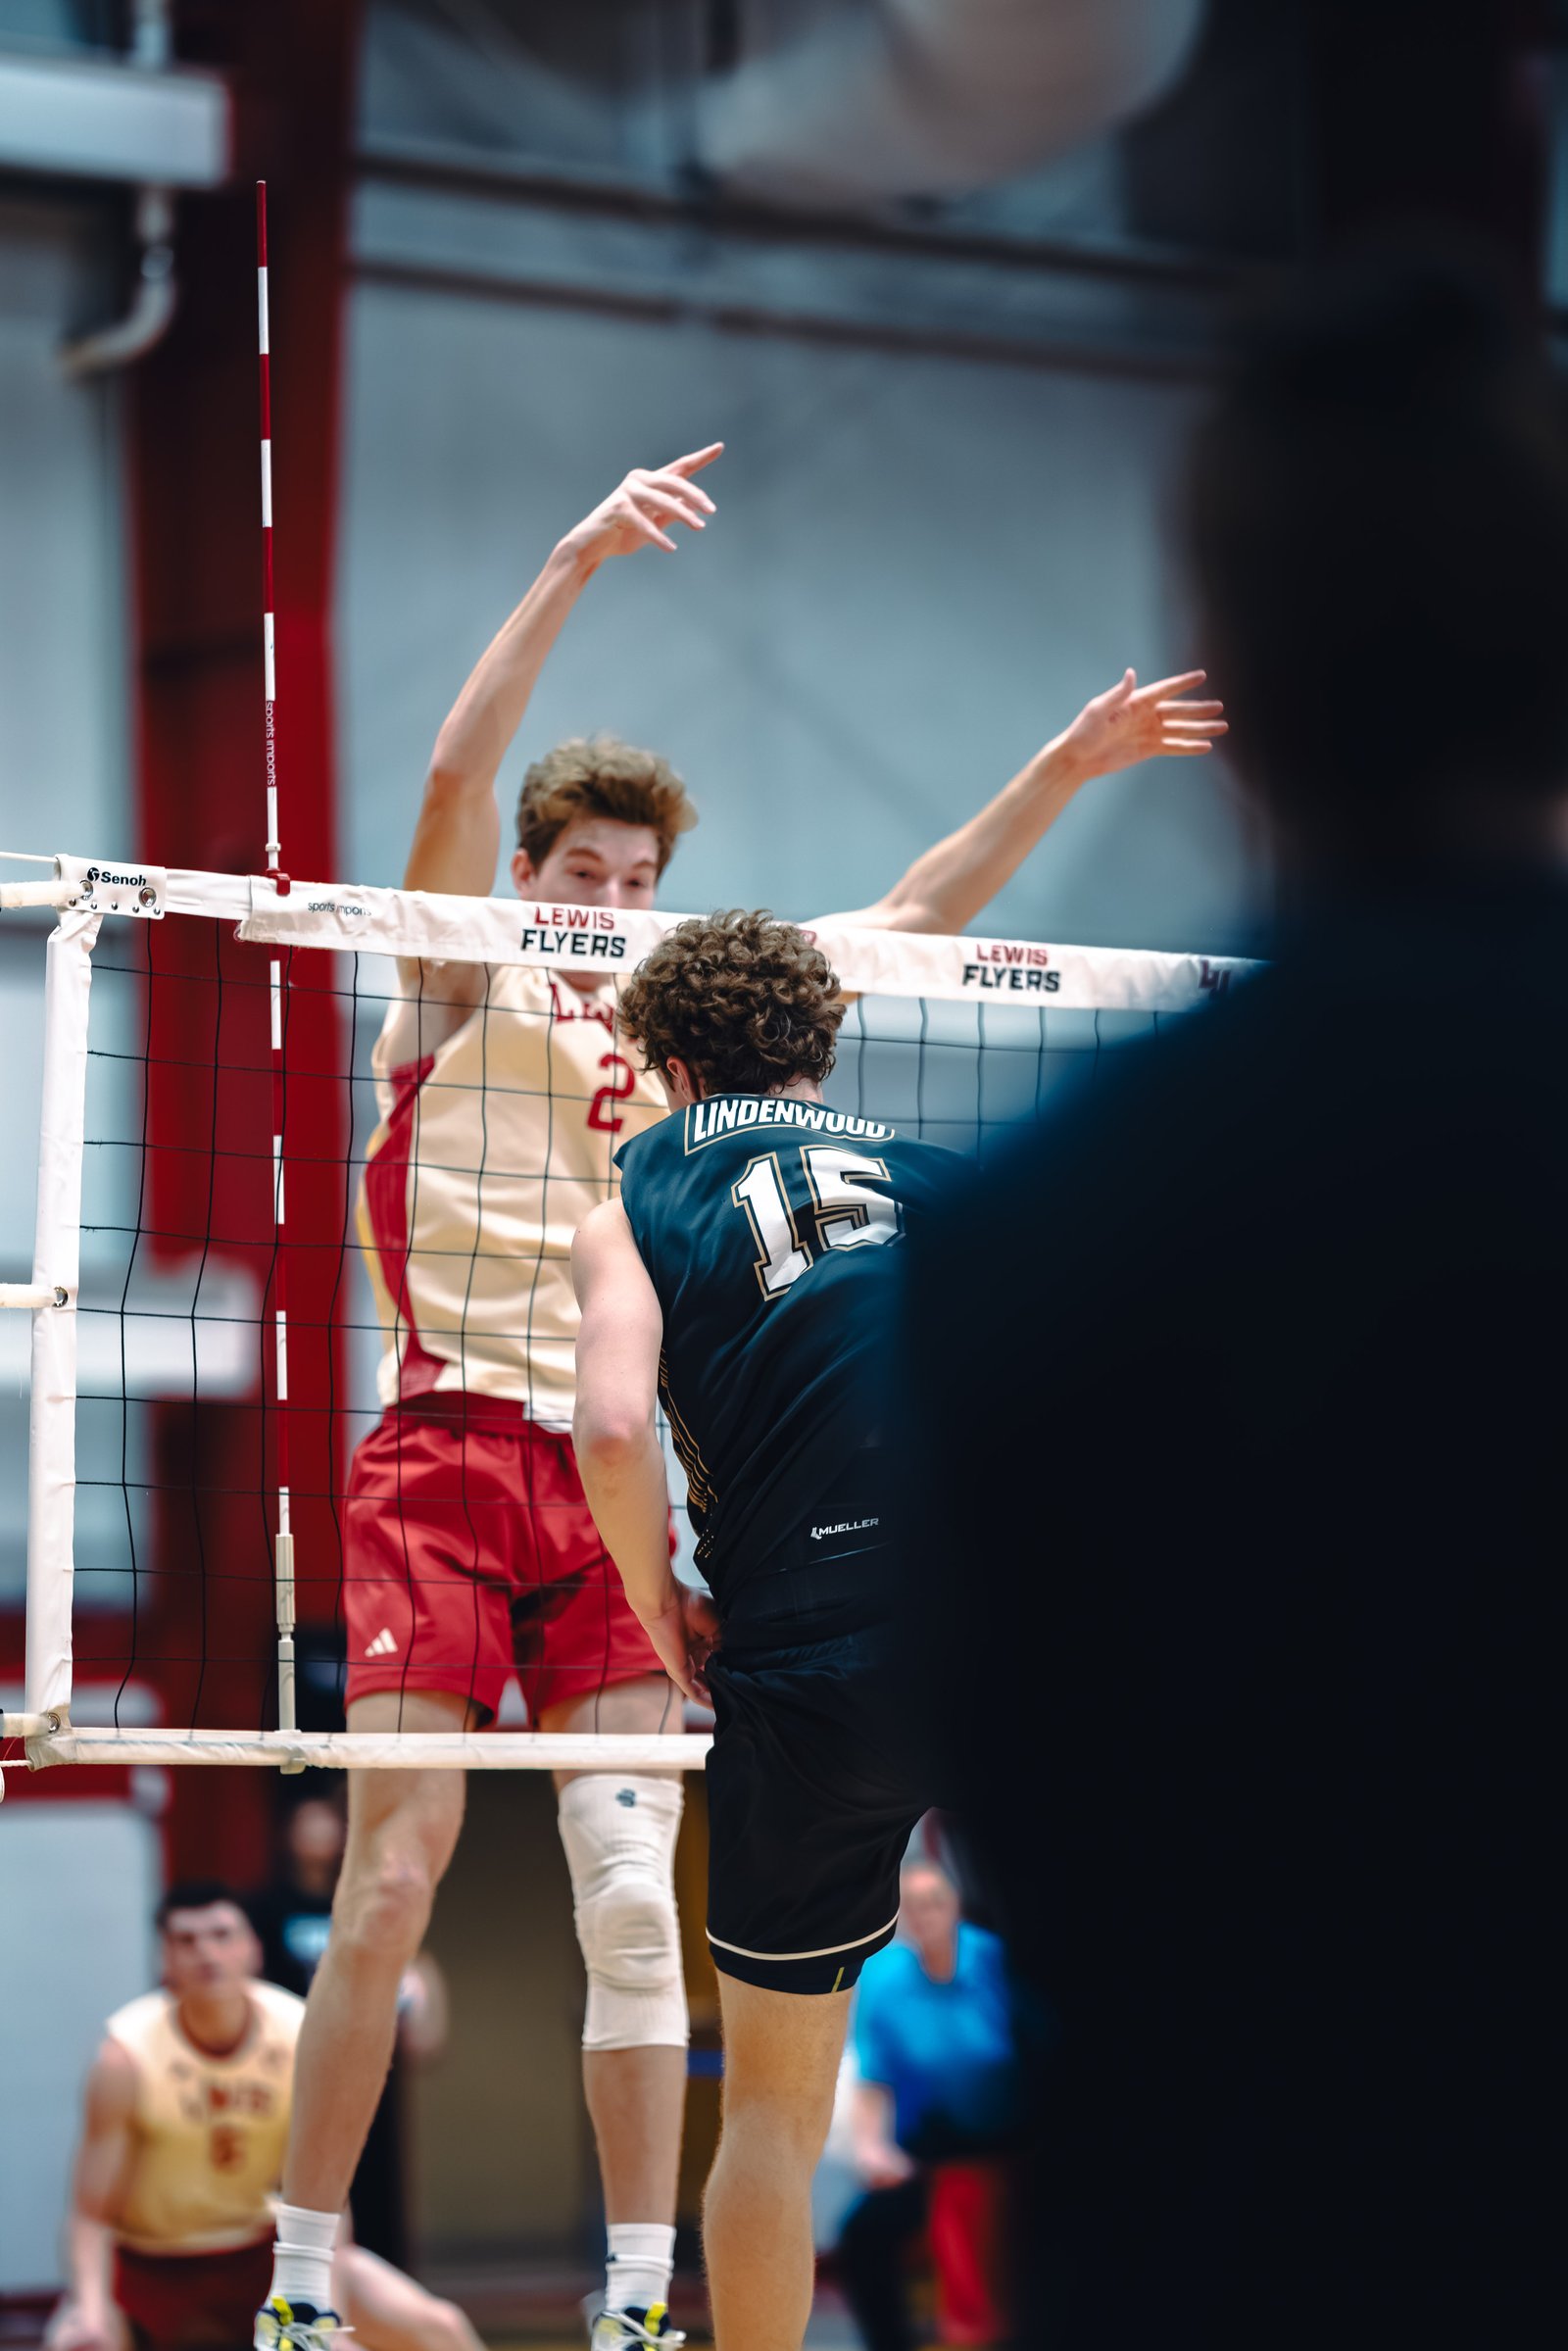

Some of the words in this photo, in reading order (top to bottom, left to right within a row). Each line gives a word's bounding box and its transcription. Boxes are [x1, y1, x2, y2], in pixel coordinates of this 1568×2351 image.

[101, 871, 146, 886] Senoh
[308, 902, 335, 912] sports
[535, 906, 614, 930] LEWIS
[521, 929, 626, 958] FLYERS
[976, 944, 1049, 966] LEWIS
[962, 964, 1061, 993] FLYERS
[586, 1053, 635, 1133] 2
[693, 1099, 886, 1144] LINDENWOOD
[731, 1145, 906, 1301] 15
[818, 1518, 879, 1537] MUELLER
